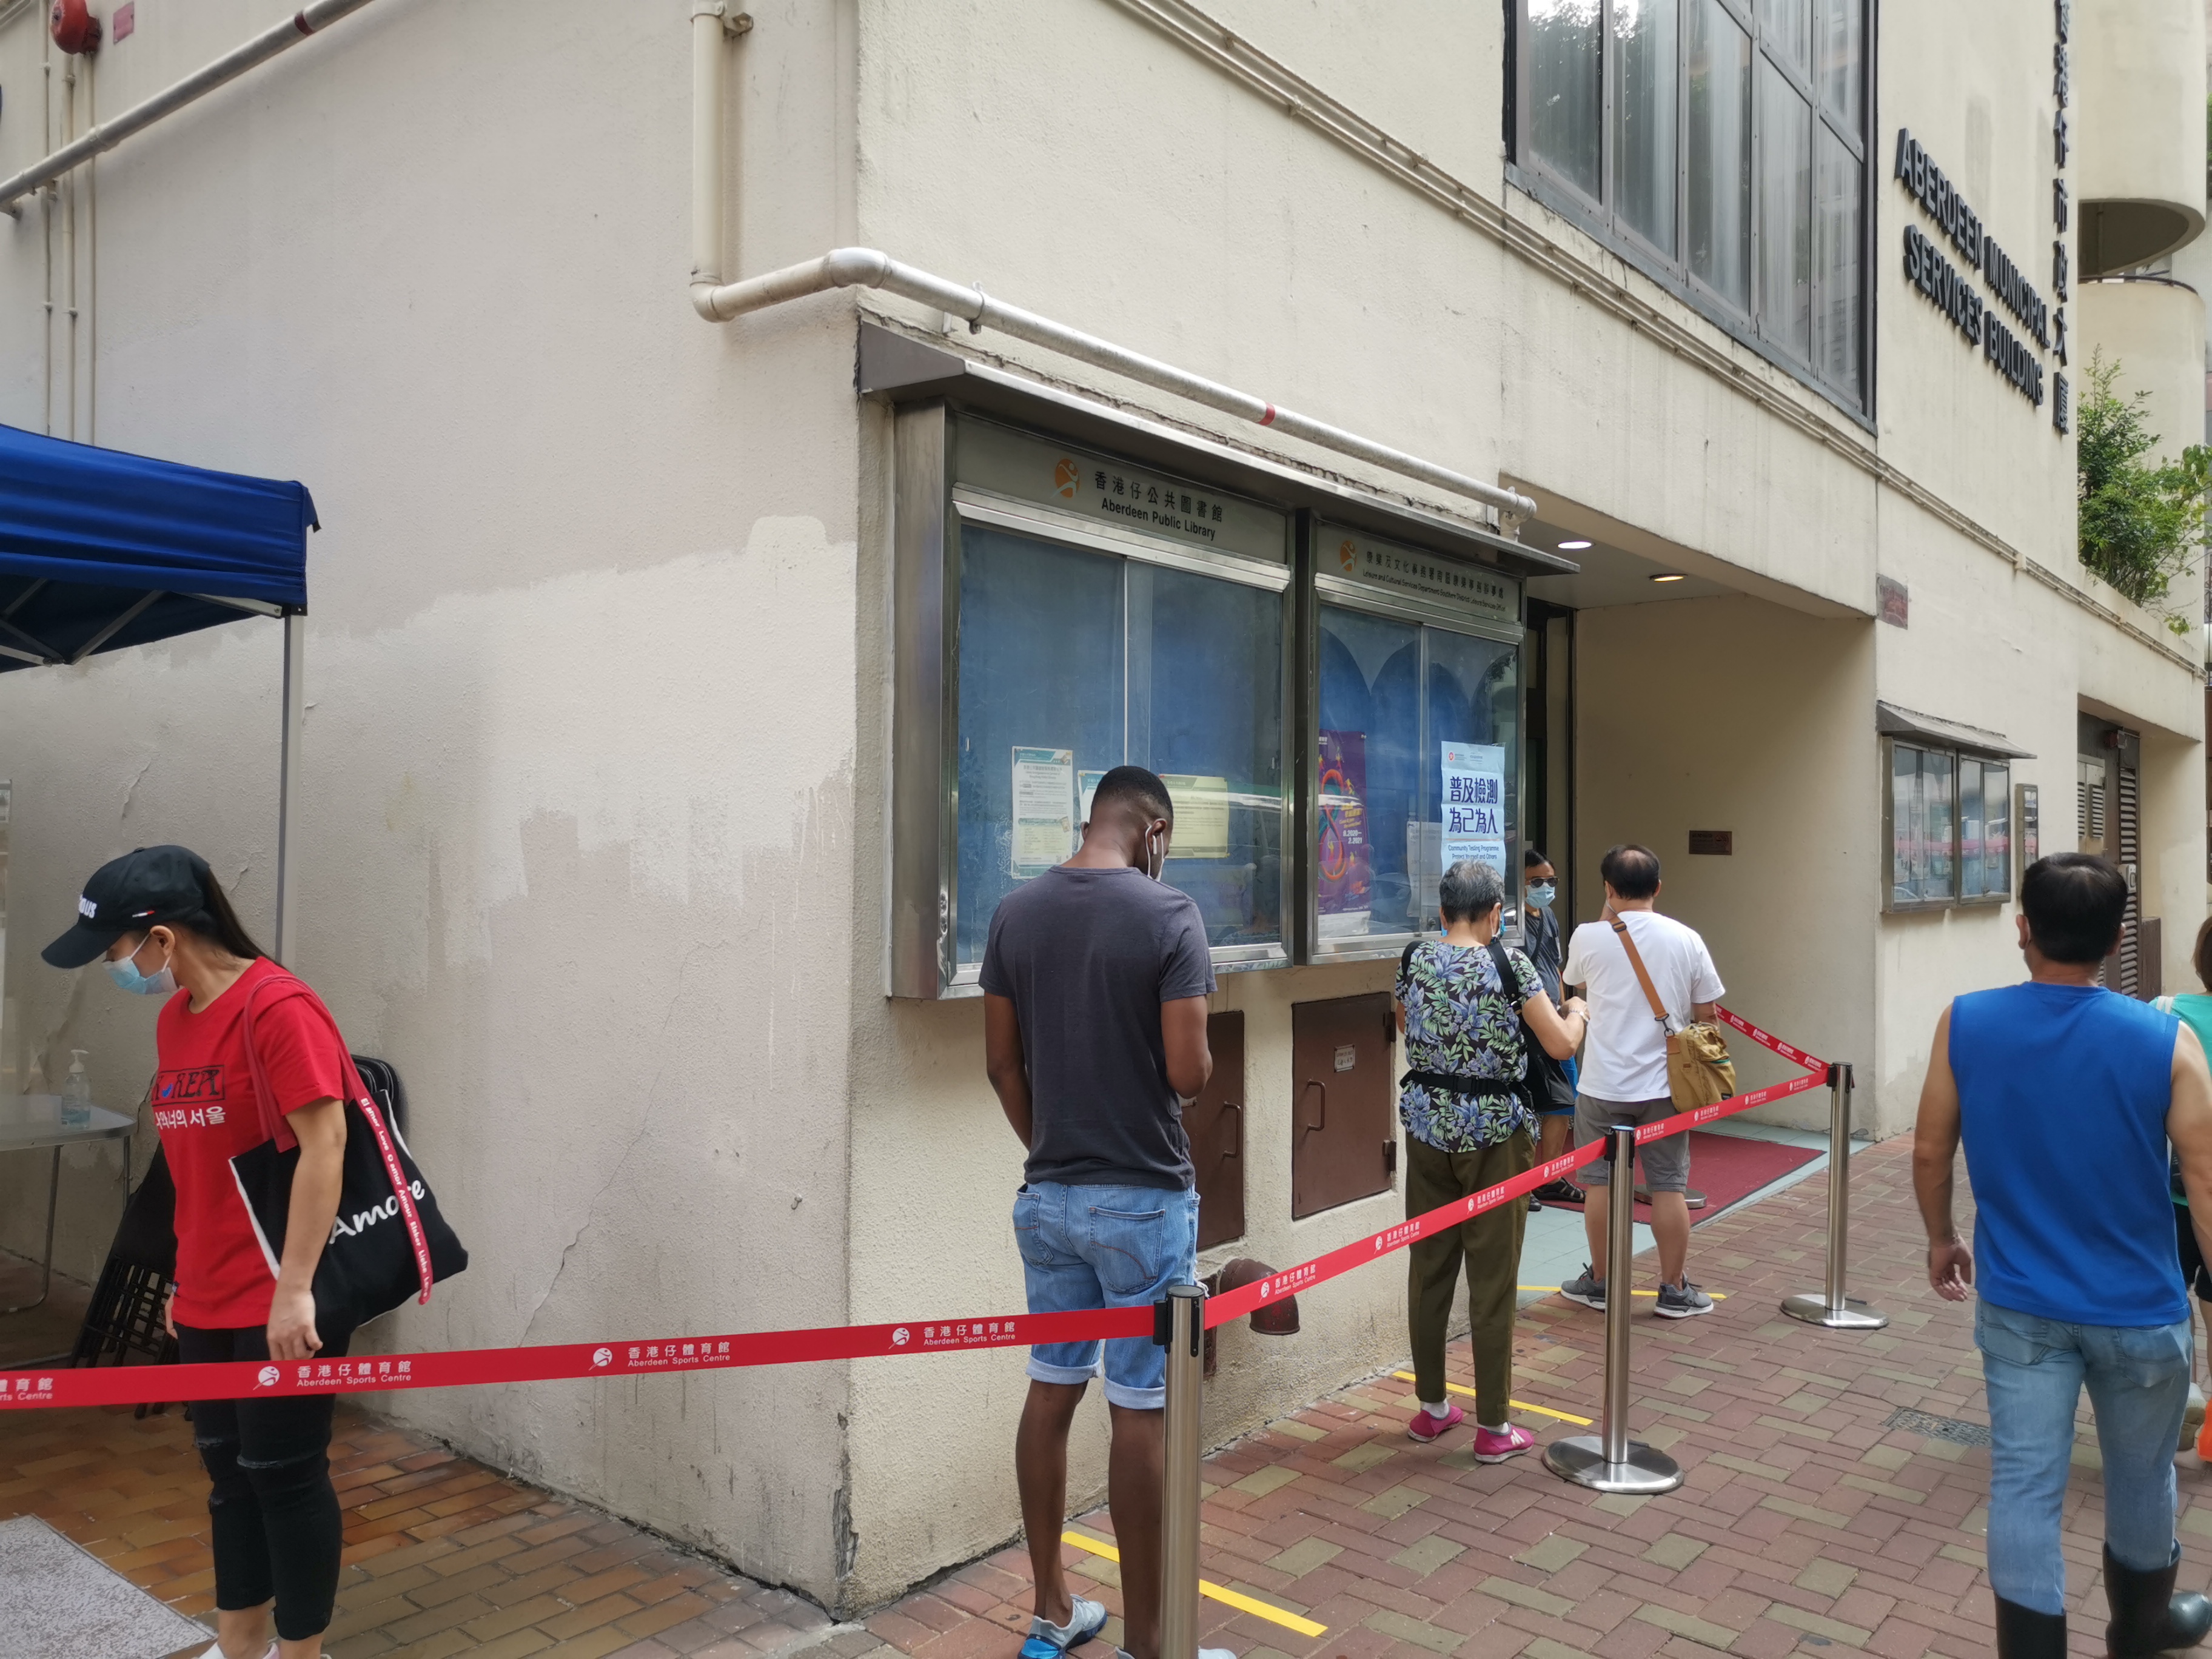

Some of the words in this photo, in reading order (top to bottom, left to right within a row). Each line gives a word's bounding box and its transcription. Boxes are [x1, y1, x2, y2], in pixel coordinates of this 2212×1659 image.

[1894, 127, 1983, 270] ABERDEEN
[1985, 235, 2050, 349] MUNICIPAL
[1903, 224, 1983, 346] SERVICES
[1985, 310, 2043, 406] BUILDING
[1094, 471, 1223, 523] 香港仔公共圖書館
[1101, 497, 1149, 522] Aberdeen
[1152, 511, 1181, 530] Public
[1184, 519, 1216, 541] Library
[1449, 776, 1498, 805] 普及檢測
[1449, 807, 1498, 834] 為己為人
[79, 894, 98, 919] OUS
[190, 1106, 226, 1127] 서울
[366, 1107, 381, 1127] amor
[379, 1130, 389, 1151] Love
[390, 1164, 402, 1185] amor
[398, 1190, 412, 1218] Amour
[329, 1179, 425, 1244] Amoe
[923, 1321, 1015, 1338] 香港仔體育館
[923, 1338, 960, 1346] Aberdeen
[964, 1335, 987, 1344] Sports
[628, 1341, 730, 1359] 香港仔體育館
[628, 1359, 668, 1367] Aberdeen
[672, 1356, 699, 1365] Sports
[703, 1354, 730, 1362] Centre
[297, 1360, 412, 1378] 香港仔體育館
[297, 1378, 342, 1387] Aberdeen
[346, 1376, 377, 1385] Sports
[381, 1374, 412, 1382] Centre
[18, 1392, 53, 1401] Centre
